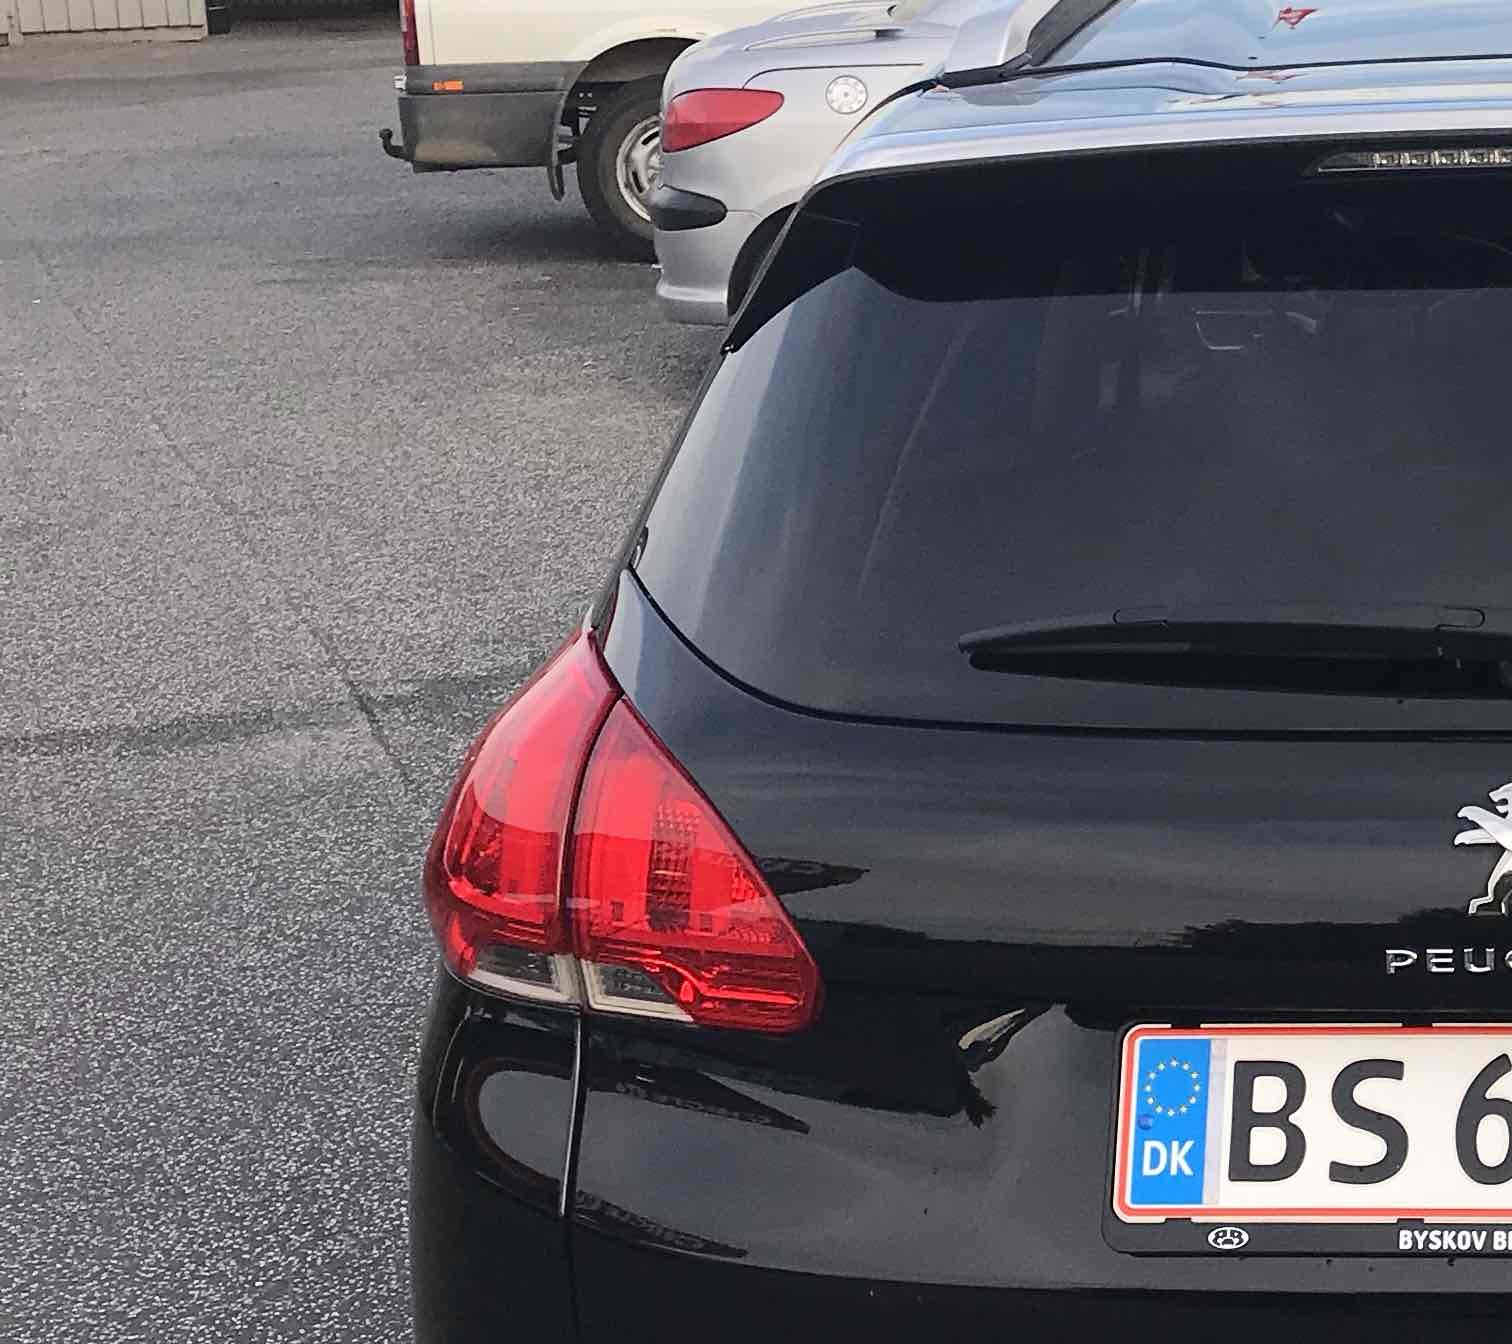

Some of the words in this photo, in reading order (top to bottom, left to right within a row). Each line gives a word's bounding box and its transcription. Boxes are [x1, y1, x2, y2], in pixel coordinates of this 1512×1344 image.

[1228, 1058, 1409, 1185] BS
[1142, 1139, 1195, 1177] DK
[1399, 1229, 1486, 1251] BYSKOV
